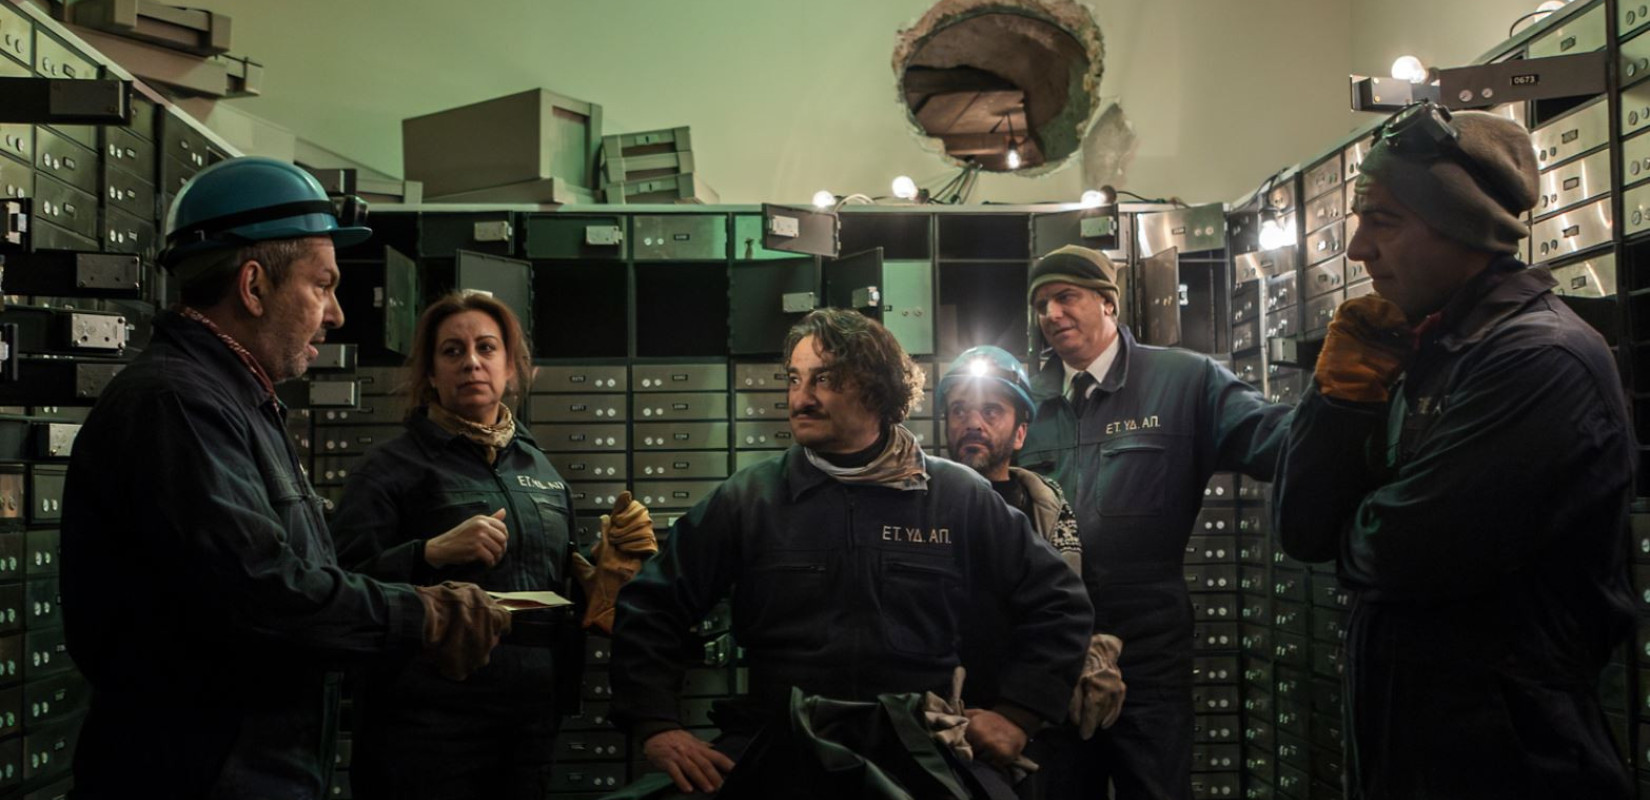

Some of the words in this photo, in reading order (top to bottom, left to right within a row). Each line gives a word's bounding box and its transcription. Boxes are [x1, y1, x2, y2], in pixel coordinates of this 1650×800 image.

[1513, 75, 1536, 85] 0673
[882, 525, 902, 541] ΕΤ.
[905, 527, 926, 543] ΥΔ.
[928, 528, 952, 544] ΑΠ.
